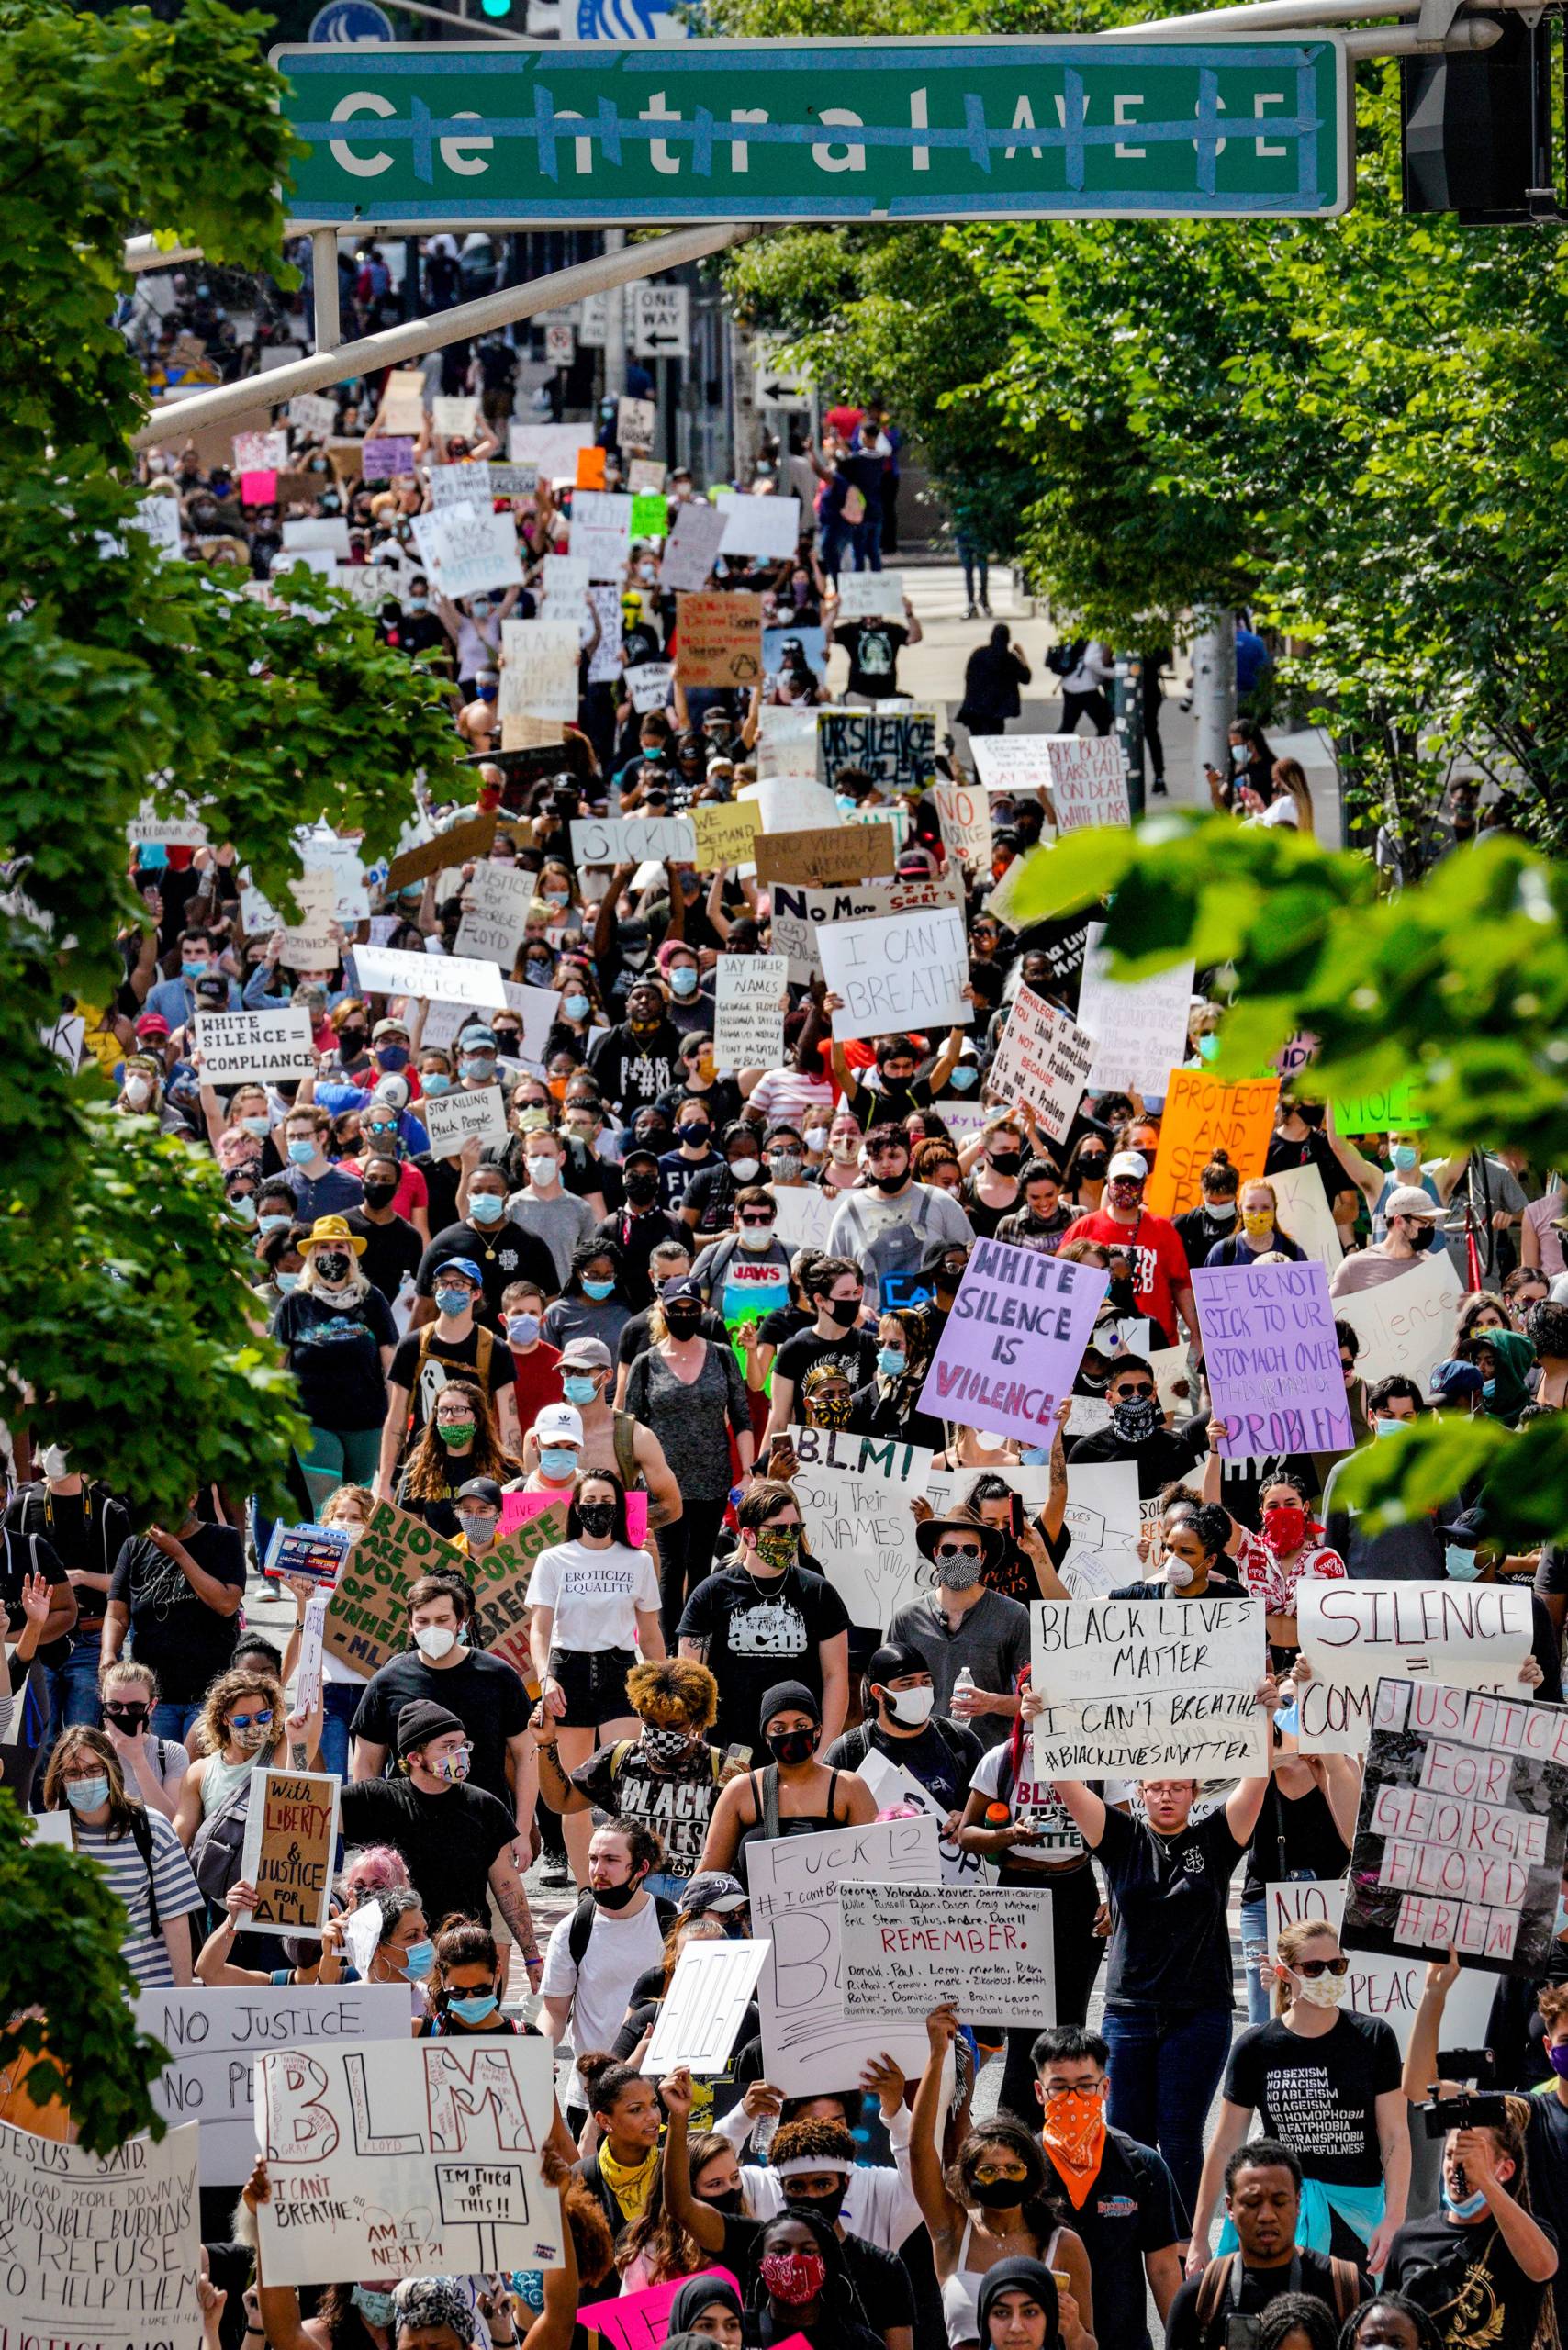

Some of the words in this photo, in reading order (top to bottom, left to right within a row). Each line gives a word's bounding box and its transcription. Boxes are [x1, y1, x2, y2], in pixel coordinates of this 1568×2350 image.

[330, 86, 930, 177] Central
[1004, 95, 1147, 159] AVE
[1195, 93, 1287, 157] SE
[642, 293, 677, 307] ONE
[644, 313, 679, 325] WAY
[1078, 737, 1119, 761] BOYS
[1060, 783, 1084, 800] ON
[1089, 778, 1124, 800] DEAF
[697, 811, 721, 827] WE
[936, 790, 974, 827] NO
[696, 824, 755, 845] DEMAND
[475, 867, 533, 897] JUSTICE
[462, 921, 509, 950] FLOYD
[843, 934, 867, 968] I
[884, 918, 958, 964] CAN'T
[724, 959, 745, 972] SAY
[752, 959, 785, 972] THEIR
[391, 974, 472, 998] POLICE
[734, 979, 778, 993] NAMES
[846, 960, 969, 1020] BREATHE
[201, 1015, 260, 1032] WHITE
[1018, 987, 1056, 1023] PRIVILEGE
[1058, 1017, 1066, 1034] is
[1072, 1029, 1091, 1050] when
[203, 1029, 286, 1048] SILENCE
[1014, 1002, 1029, 1023] YOU
[1035, 1018, 1054, 1044] think
[1058, 1040, 1092, 1080] something
[207, 1052, 314, 1072] COMPLIANCE
[996, 1051, 1009, 1073] it's
[1020, 1056, 1055, 1088] BECAUSE
[1017, 1033, 1035, 1051] NOT
[1047, 1053, 1075, 1086] Problem
[428, 1100, 451, 1117] STOP
[452, 1091, 489, 1113] KILLING
[1001, 1083, 1016, 1099] you
[1013, 1070, 1026, 1089] not
[1038, 1090, 1066, 1124] Problem
[1172, 1077, 1277, 1122] PROTECT
[431, 1122, 459, 1139] Black
[461, 1113, 494, 1135] People
[1195, 1119, 1246, 1149] AND
[734, 1264, 780, 1281] JAWS
[972, 1241, 1077, 1295] WHITE
[1199, 1272, 1239, 1303] IF
[1247, 1273, 1275, 1300] UR
[1276, 1269, 1321, 1298] NOT
[953, 1285, 1072, 1342] SILENCE
[1204, 1306, 1252, 1339] SICK
[1254, 1304, 1285, 1333] TO
[1292, 1301, 1328, 1329] UR
[991, 1334, 1024, 1366] IS
[1209, 1345, 1289, 1382] STOMACH
[1294, 1339, 1342, 1373] OVER
[936, 1360, 1055, 1426] VIOLENCE
[1211, 1380, 1255, 1404] THIS
[1255, 1395, 1280, 1411] THE
[1224, 1404, 1356, 1458] PROBLEM
[798, 1427, 913, 1483] B.L.M!
[508, 1502, 537, 1519] LIVE
[791, 1474, 840, 1519] Say
[841, 1479, 889, 1514] Their
[820, 1516, 906, 1550] NAMES
[361, 1534, 408, 1569] ARE
[342, 1576, 377, 1605] OF
[565, 1570, 634, 1584] EROTICIZE
[565, 1581, 633, 1594] EQUALITY
[1041, 1605, 1145, 1651] BLACK
[1159, 1601, 1257, 1637] LIVES
[1316, 1589, 1524, 1648] SILENCE
[1114, 1641, 1213, 1679] MATTER
[1043, 1705, 1066, 1738] I
[1081, 1698, 1153, 1734] CAN'T
[1170, 1694, 1258, 1726] BREATHE
[1380, 1682, 1568, 1762] JUSTICE
[1427, 1743, 1507, 1801] FOR
[270, 1780, 313, 1803] With
[620, 1775, 712, 1821] BLACK
[1377, 1789, 1546, 1857] GEORGE
[287, 1841, 301, 1864] &
[770, 1837, 872, 1884] FUCK
[888, 1827, 923, 1859] 12
[257, 1858, 325, 1892] JUSTICE
[1388, 1843, 1529, 1905] FLOYD
[274, 1889, 299, 1907] FOR
[976, 1899, 999, 1911] Craig
[1005, 1900, 1040, 1912] Michael
[253, 1900, 317, 1927] ALL
[845, 1913, 865, 1927] Eric
[1399, 1895, 1512, 1953] #BLM
[162, 2005, 209, 2045] NO
[1266, 2069, 1281, 2079] NO
[1282, 2067, 1327, 2078] SEXISM
[1267, 2079, 1280, 2089] NO
[1282, 2077, 1328, 2088] RACISM
[163, 2076, 204, 2112] NO
[263, 2046, 536, 2165] BLM
[1267, 2091, 1279, 2101] NO
[1281, 2087, 1338, 2100] ABLEISM
[1267, 2102, 1280, 2112] NO
[1282, 2099, 1331, 2111] AGEISM
[1271, 2113, 1282, 2122] NO
[1284, 2109, 1364, 2122] HOMOPHOBIA
[1286, 2120, 1350, 2133] FATPHOBIA
[1291, 2130, 1364, 2143] TRANSPHOBIA
[1294, 2142, 1365, 2154] HATEFULNESS
[274, 2178, 285, 2201] I
[290, 2176, 332, 2199] CAN'T
[442, 2168, 470, 2184] IM
[469, 2183, 483, 2198] OF
[24, 2178, 61, 2202] LOAD
[71, 2189, 116, 2207] PEOPLE
[127, 2177, 173, 2207] DOWN
[110, 2198, 191, 2239] BURDENS
[368, 2222, 398, 2244] AM
[402, 2222, 419, 2242] I
[38, 2232, 182, 2277] REFUSE
[40, 2272, 116, 2310] HELP
[124, 2268, 203, 2311] THEM
[140, 2315, 167, 2327] LUKE
